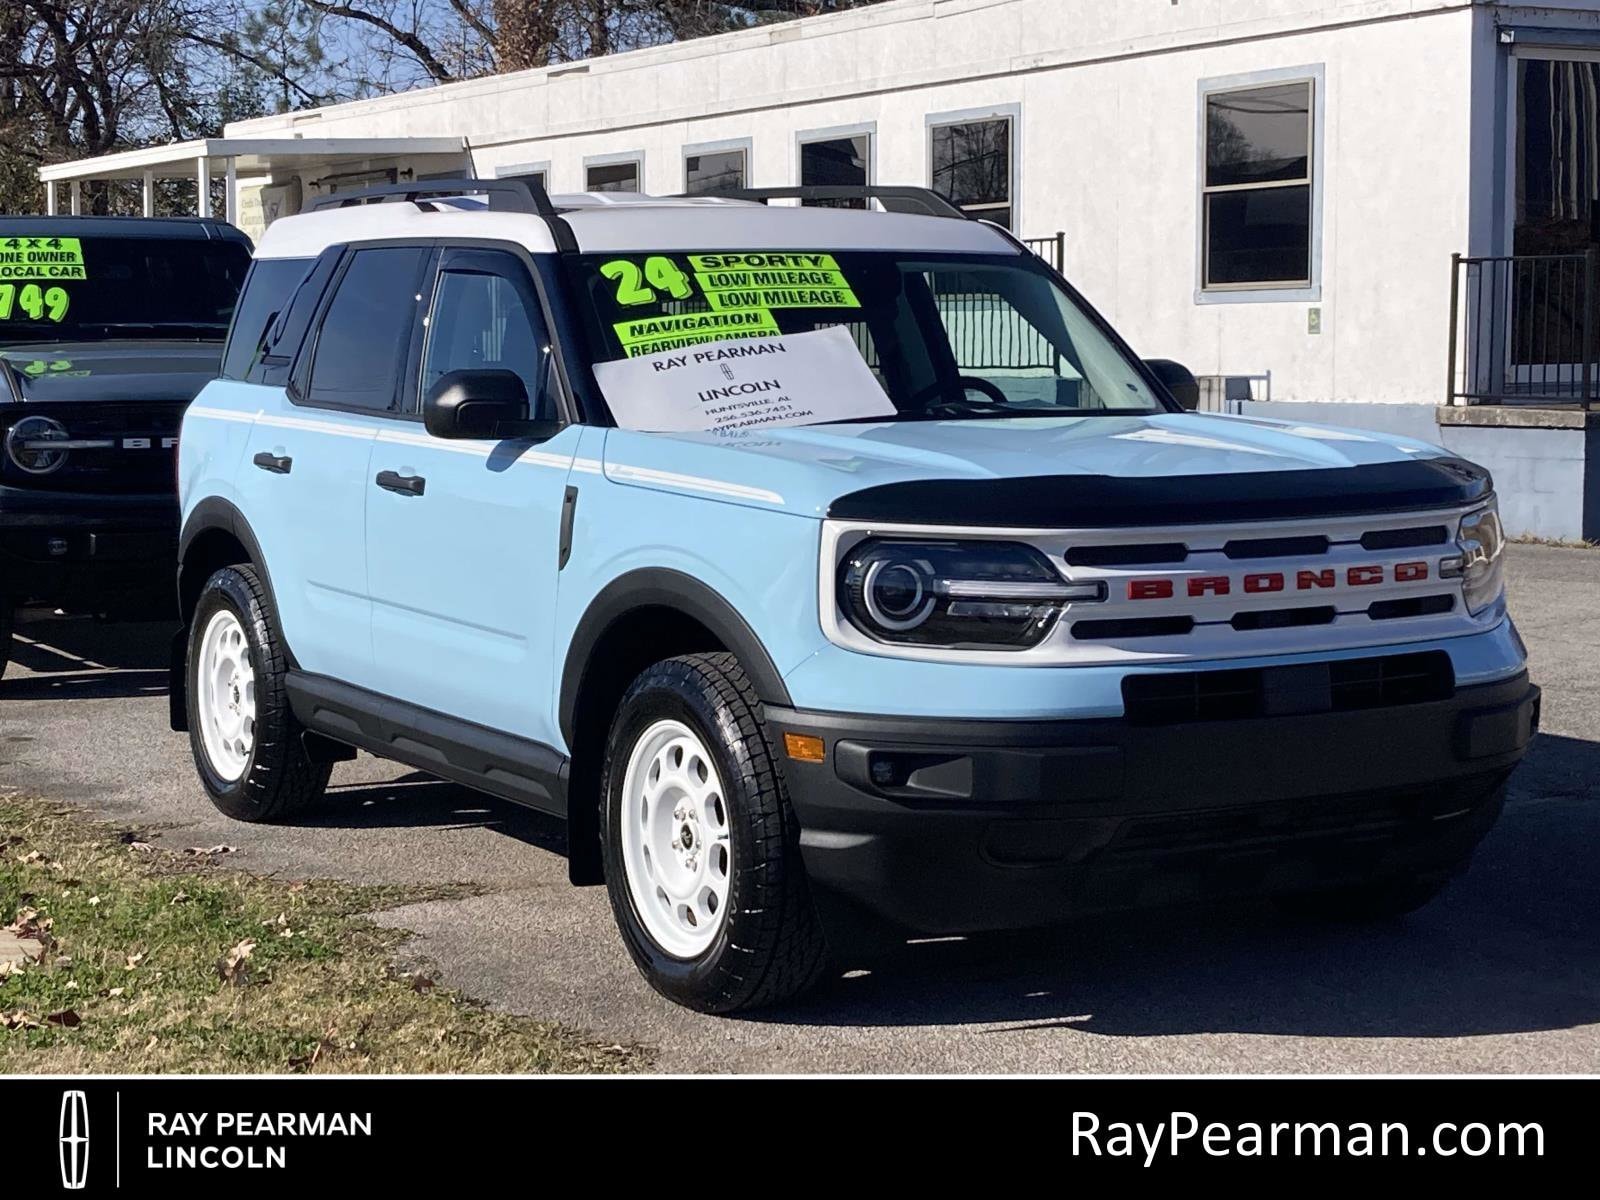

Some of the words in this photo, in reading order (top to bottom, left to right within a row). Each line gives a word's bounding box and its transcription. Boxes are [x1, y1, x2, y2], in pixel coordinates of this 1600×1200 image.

[27, 251, 77, 263] OWNER
[700, 255, 824, 270] SPORTY
[0, 266, 47, 277] OCAL
[48, 266, 83, 277] CAR
[600, 256, 693, 305] 24
[709, 273, 751, 288] LOW
[754, 271, 837, 286] MILEAGE
[718, 292, 763, 308] LOW
[764, 290, 849, 306] MILEAGE
[629, 312, 763, 338] NAVIGATION
[652, 355, 688, 372] RAY
[693, 342, 787, 364] PEARMAN
[697, 379, 782, 402] LINCOLN
[704, 410, 814, 432] AYPEARMAN.COM
[1127, 561, 1429, 600] BRONCO
